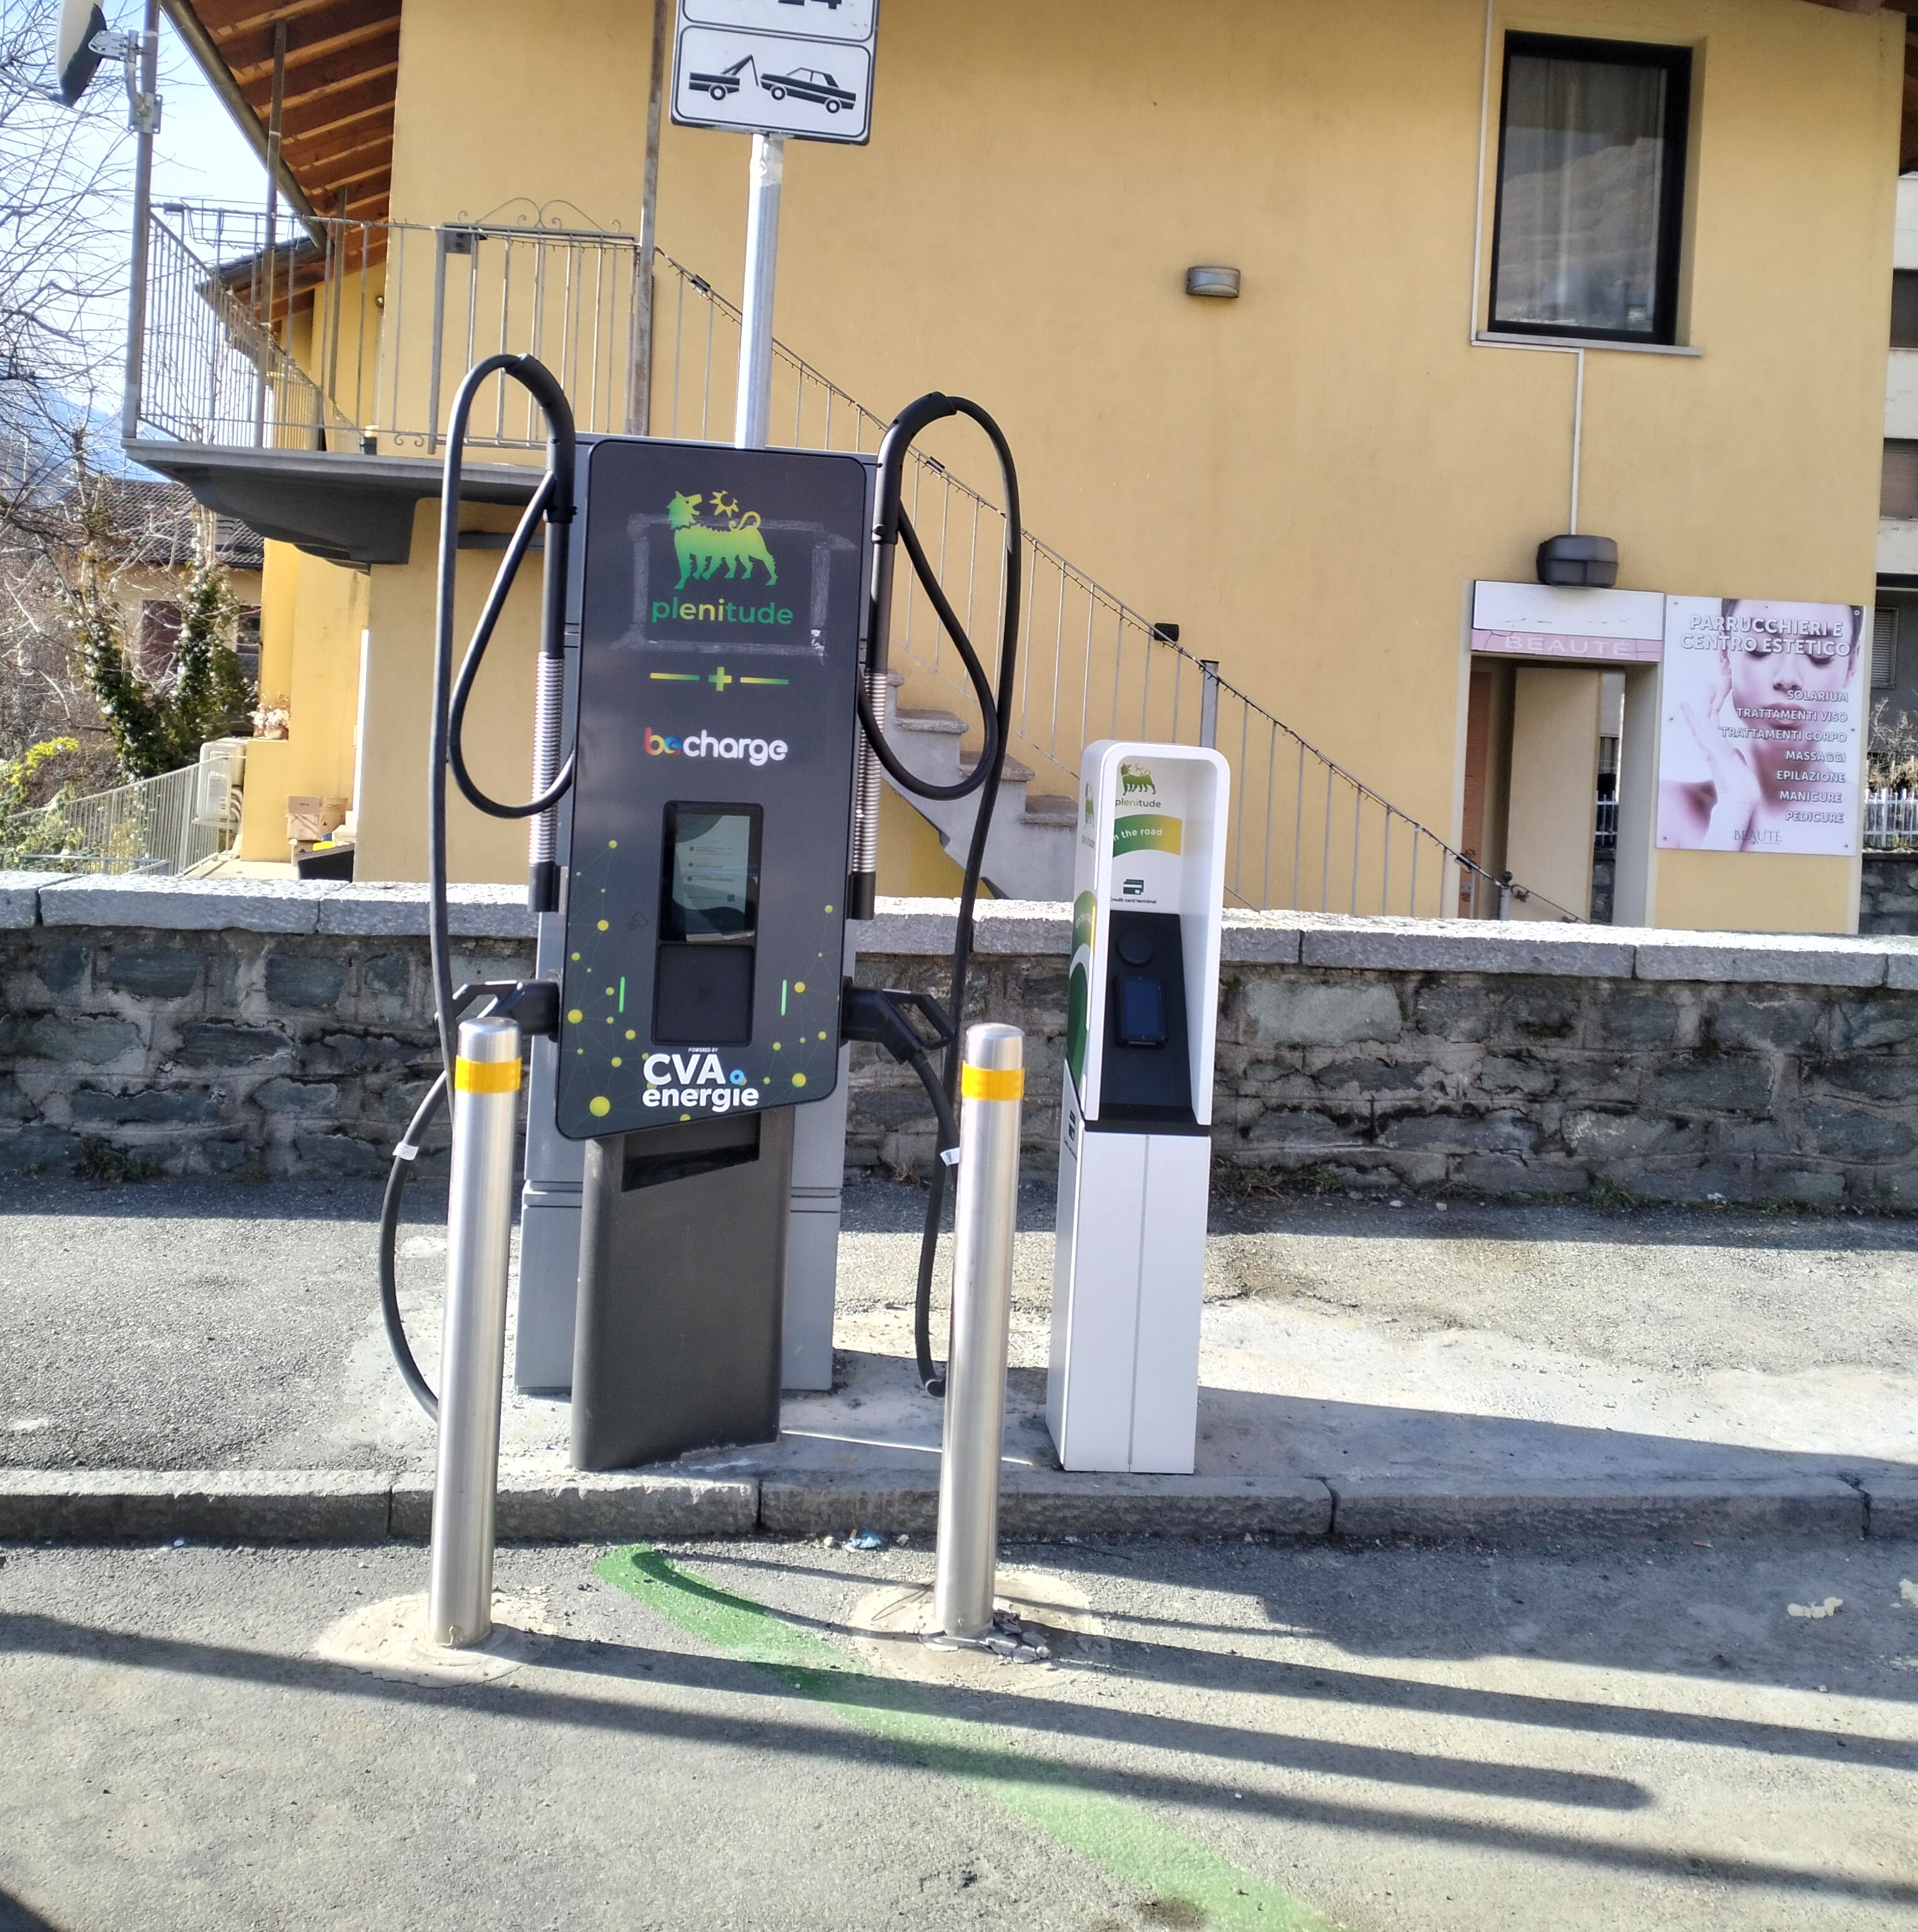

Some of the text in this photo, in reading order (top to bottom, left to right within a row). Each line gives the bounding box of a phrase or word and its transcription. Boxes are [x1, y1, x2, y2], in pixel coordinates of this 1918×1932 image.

[651, 597, 794, 624] plenitude
[1689, 614, 1843, 637] PARRUCCHIERI E
[1681, 633, 1851, 656] CENTRO ESTETICO
[1788, 690, 1848, 702] SOLARIUM
[1736, 707, 1848, 722] TRATTAMENTI VISO
[1721, 727, 1847, 742] TRATTAMENTI CORPO
[644, 727, 788, 766] becharge
[1786, 750, 1846, 762] MASSAGGI
[1777, 770, 1846, 783] EPILAZIONE
[1115, 798, 1161, 808] plenitude
[1779, 791, 1842, 803] MANICURE
[1786, 811, 1844, 823] PEDICURE
[1121, 830, 1138, 838] the
[1140, 828, 1163, 836] road
[643, 1053, 726, 1085] CVA
[642, 1087, 759, 1112] energie
